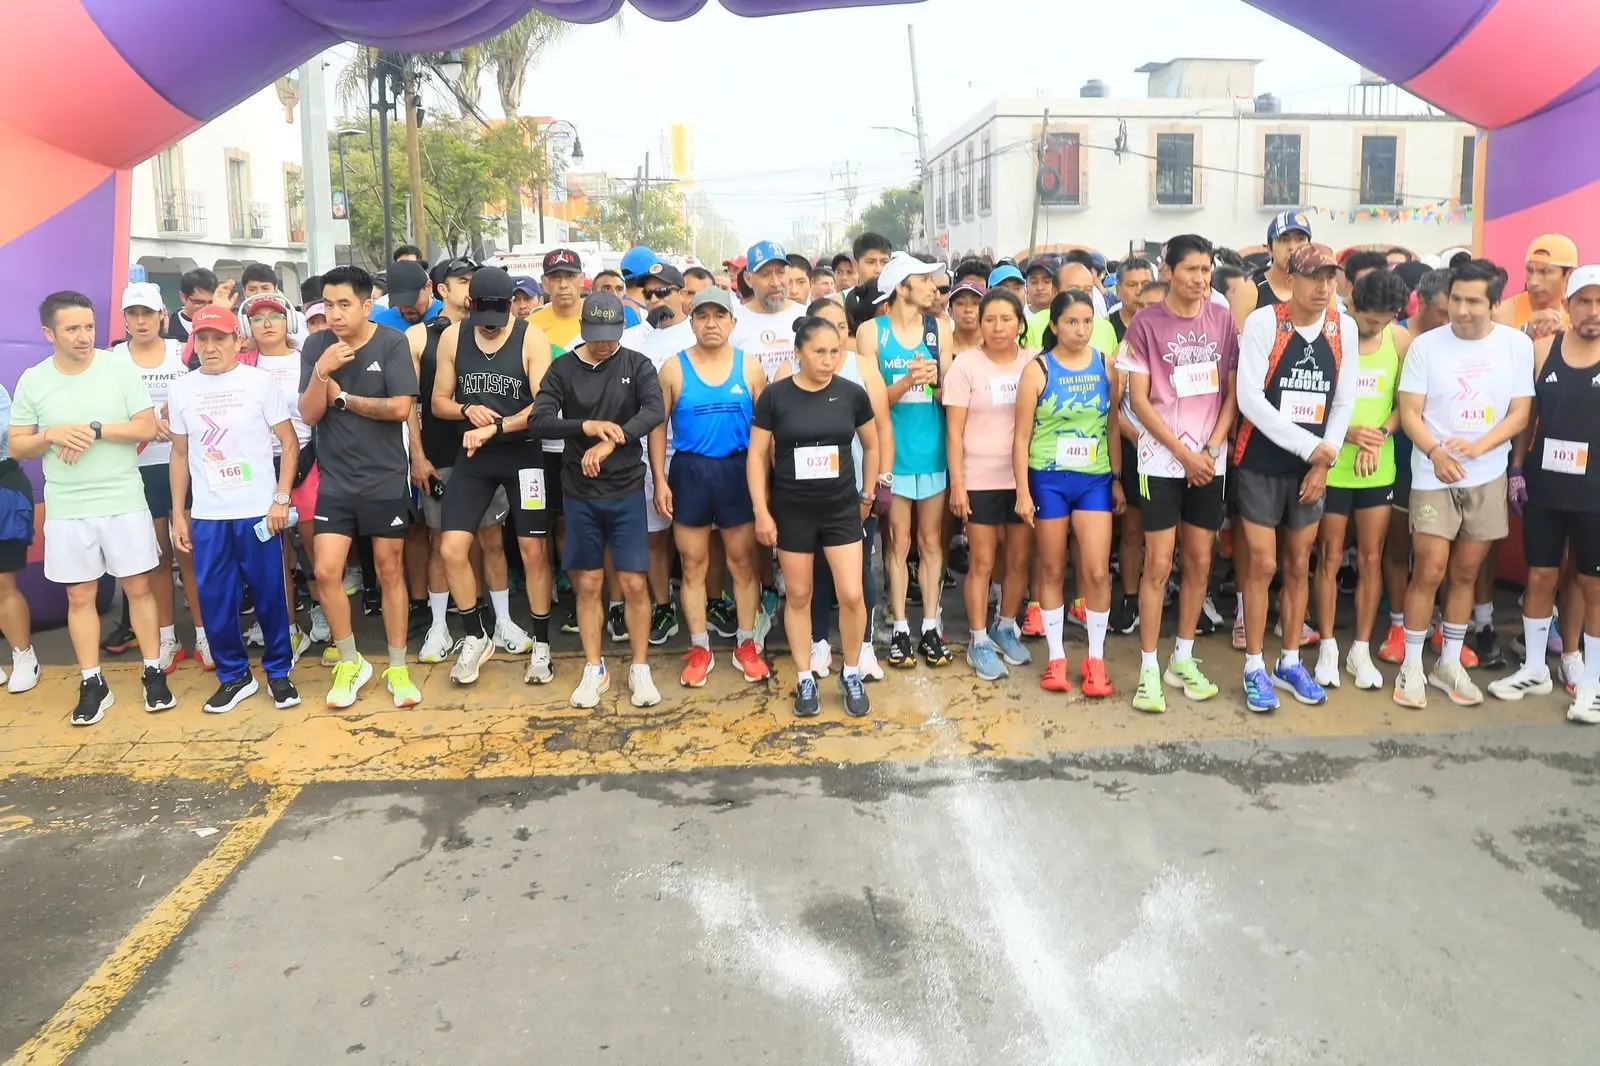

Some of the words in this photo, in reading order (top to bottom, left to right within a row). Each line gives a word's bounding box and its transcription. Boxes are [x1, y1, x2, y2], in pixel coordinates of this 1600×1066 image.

[590, 306, 615, 320] Jeep
[884, 356, 911, 369] MÉX
[1059, 376, 1074, 385] TEAM
[1290, 368, 1324, 381] TEAM
[1279, 377, 1331, 392] REGULES
[1292, 404, 1314, 417] 386
[1461, 409, 1485, 419] 433
[1067, 446, 1088, 456] 483
[806, 456, 829, 467] 037
[219, 466, 241, 478] 166
[530, 478, 539, 498] 121
